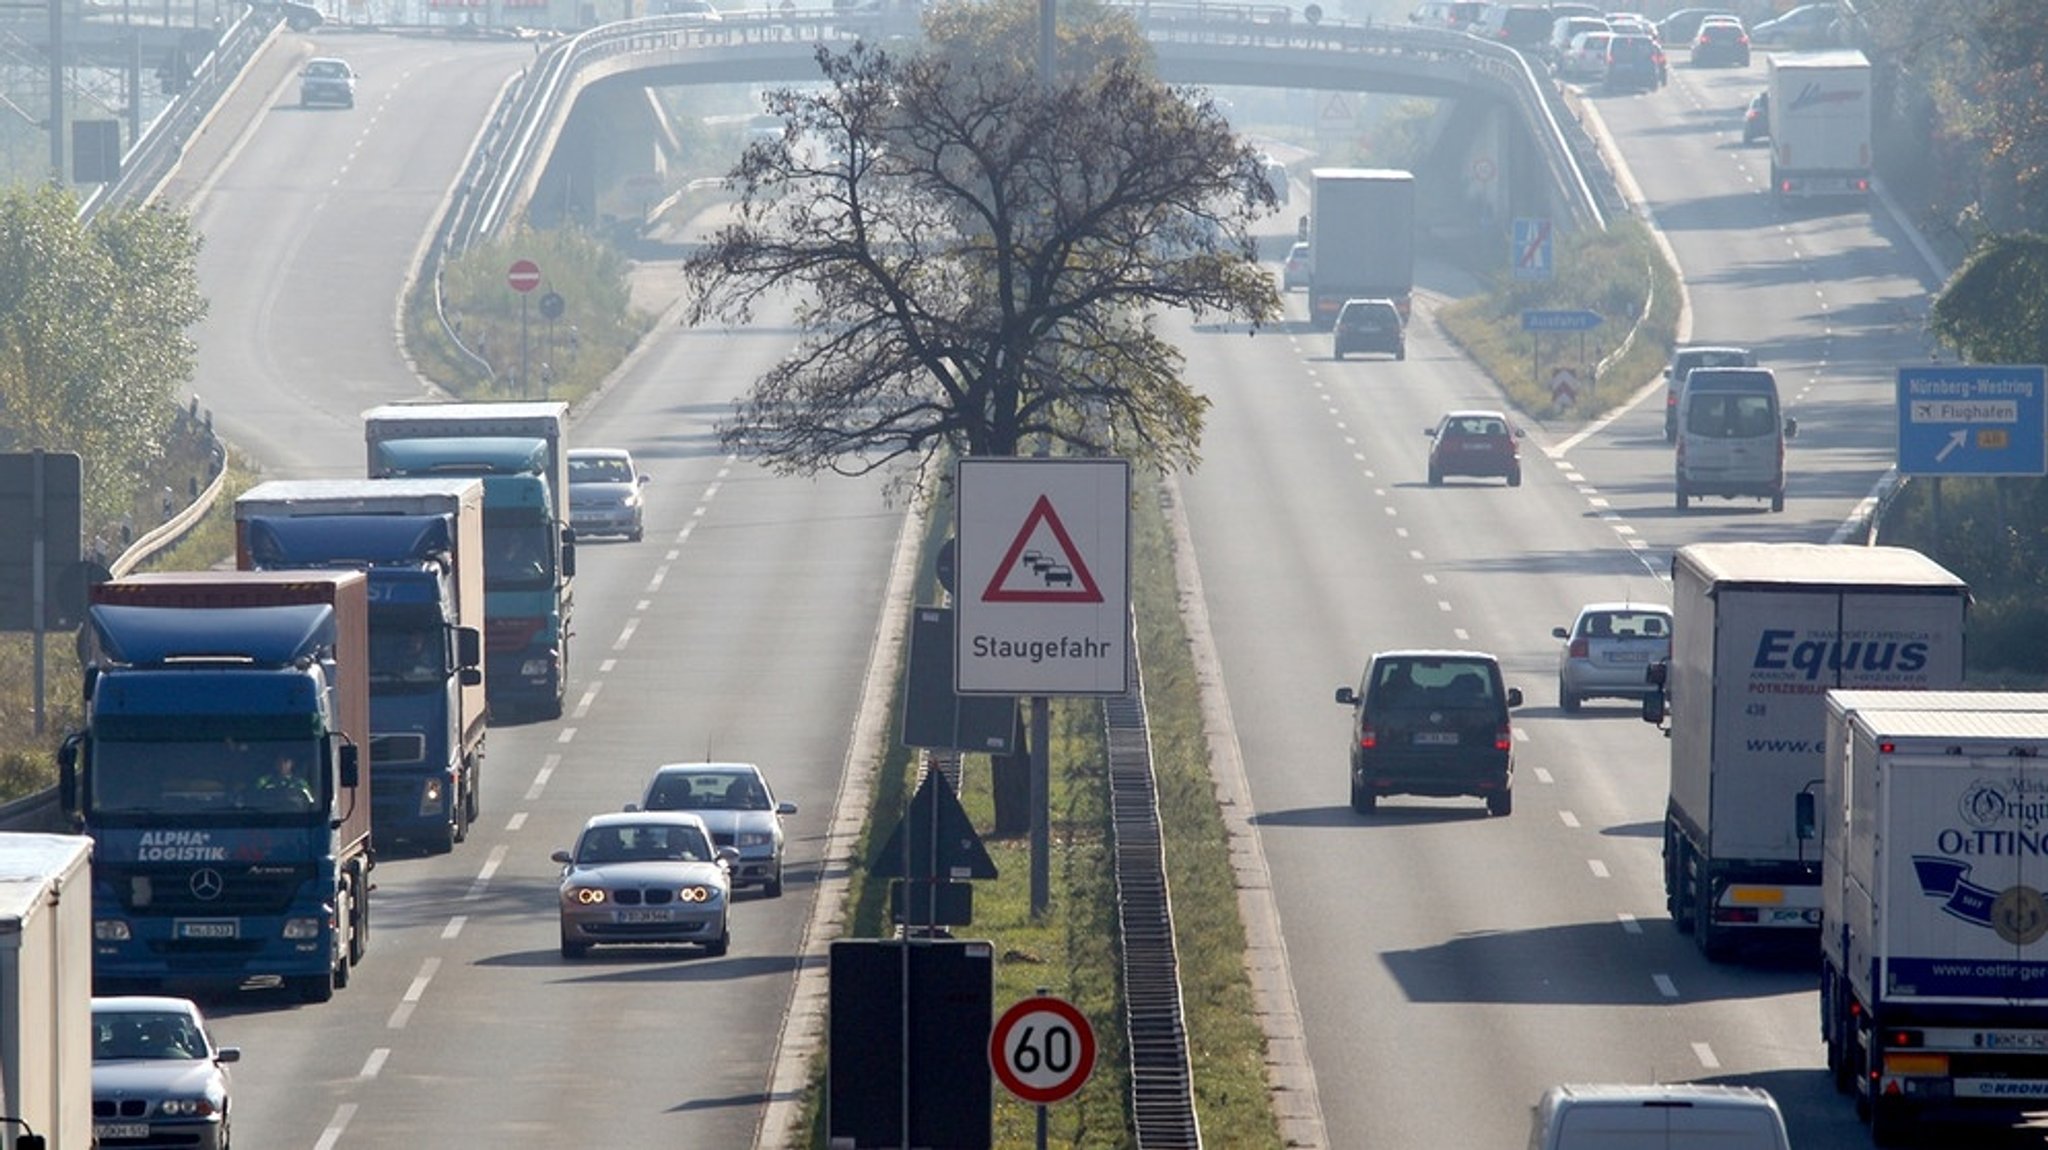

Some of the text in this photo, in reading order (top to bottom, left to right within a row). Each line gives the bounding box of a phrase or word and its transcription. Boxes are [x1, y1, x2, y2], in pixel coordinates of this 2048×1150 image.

[1909, 378, 2033, 397] Nürnberg-Westring
[1941, 404, 2014, 421] Flughafen
[973, 635, 1111, 663] Staugefahr
[1753, 629, 1929, 680] Equus
[138, 847, 226, 861] LOGISTIK
[1014, 1026, 1072, 1073] 60
